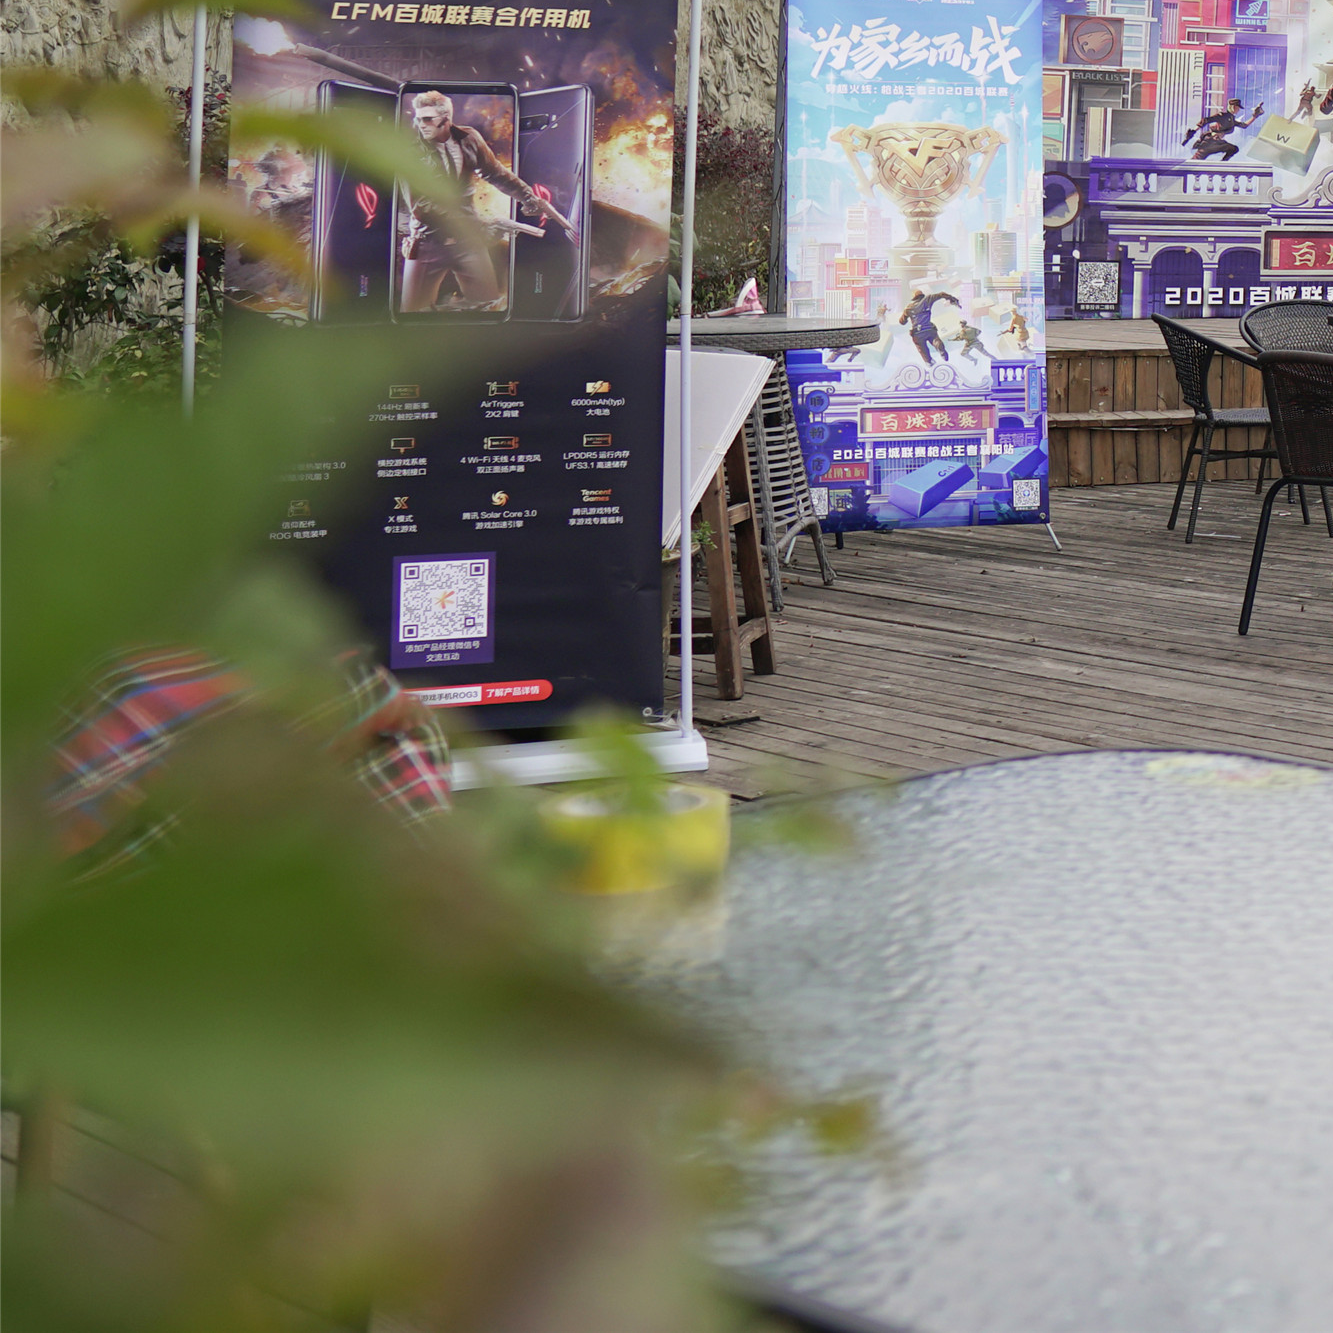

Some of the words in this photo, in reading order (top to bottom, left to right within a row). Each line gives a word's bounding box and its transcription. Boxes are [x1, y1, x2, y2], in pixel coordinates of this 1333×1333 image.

[331, 1, 592, 29] CFM百城联赛合作用机
[810, 14, 1025, 86] 为家乡而战
[879, 409, 979, 431] 百城联赛
